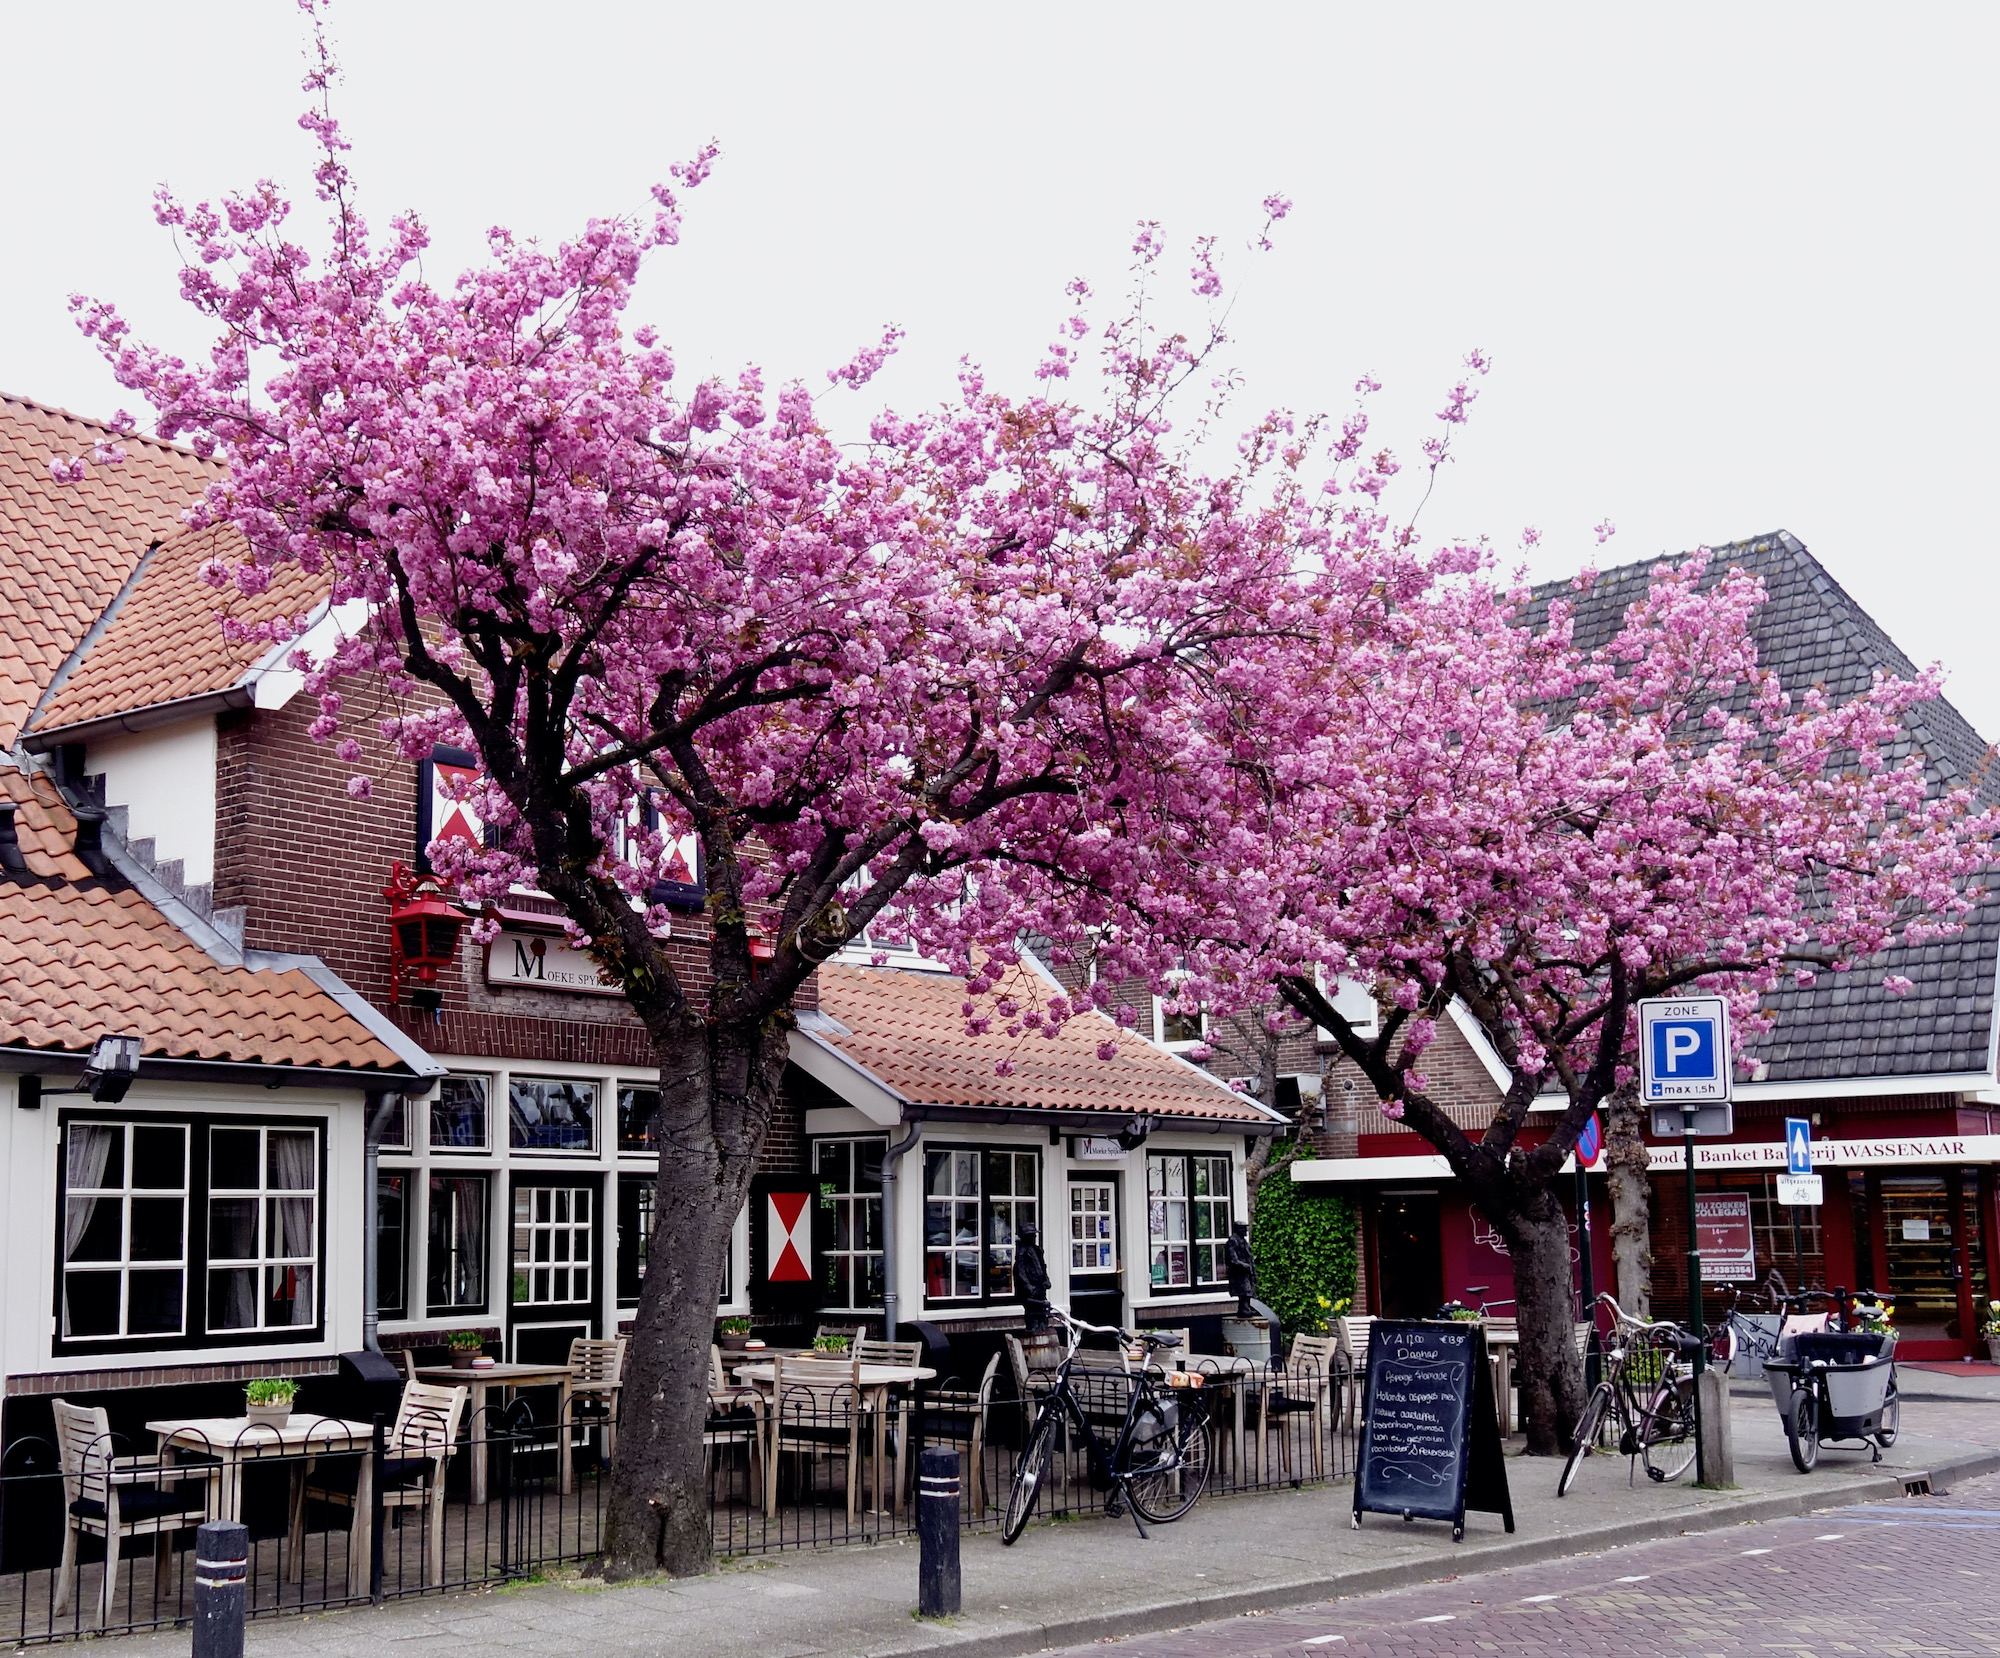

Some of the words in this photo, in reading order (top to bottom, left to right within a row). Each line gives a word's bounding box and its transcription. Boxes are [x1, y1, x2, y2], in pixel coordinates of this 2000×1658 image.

[1664, 1006, 1700, 1017] ZONE
[1665, 1027, 1701, 1073] P
[1664, 1086, 1691, 1094] max
[1700, 1148, 1758, 1163] Banket
[1763, 1145, 1836, 1162] Baerij
[1842, 1141, 1966, 1158] WASSENAAR
[1780, 1178, 1821, 1186] uitgezonderd
[1710, 1201, 1746, 1209] ZOEKEN
[1695, 1208, 1747, 1217] COLLEGA'S
[1385, 1370, 1414, 1387] Asperge
[1408, 1391, 1439, 1405] asperges
[1372, 1432, 1389, 1442] van
